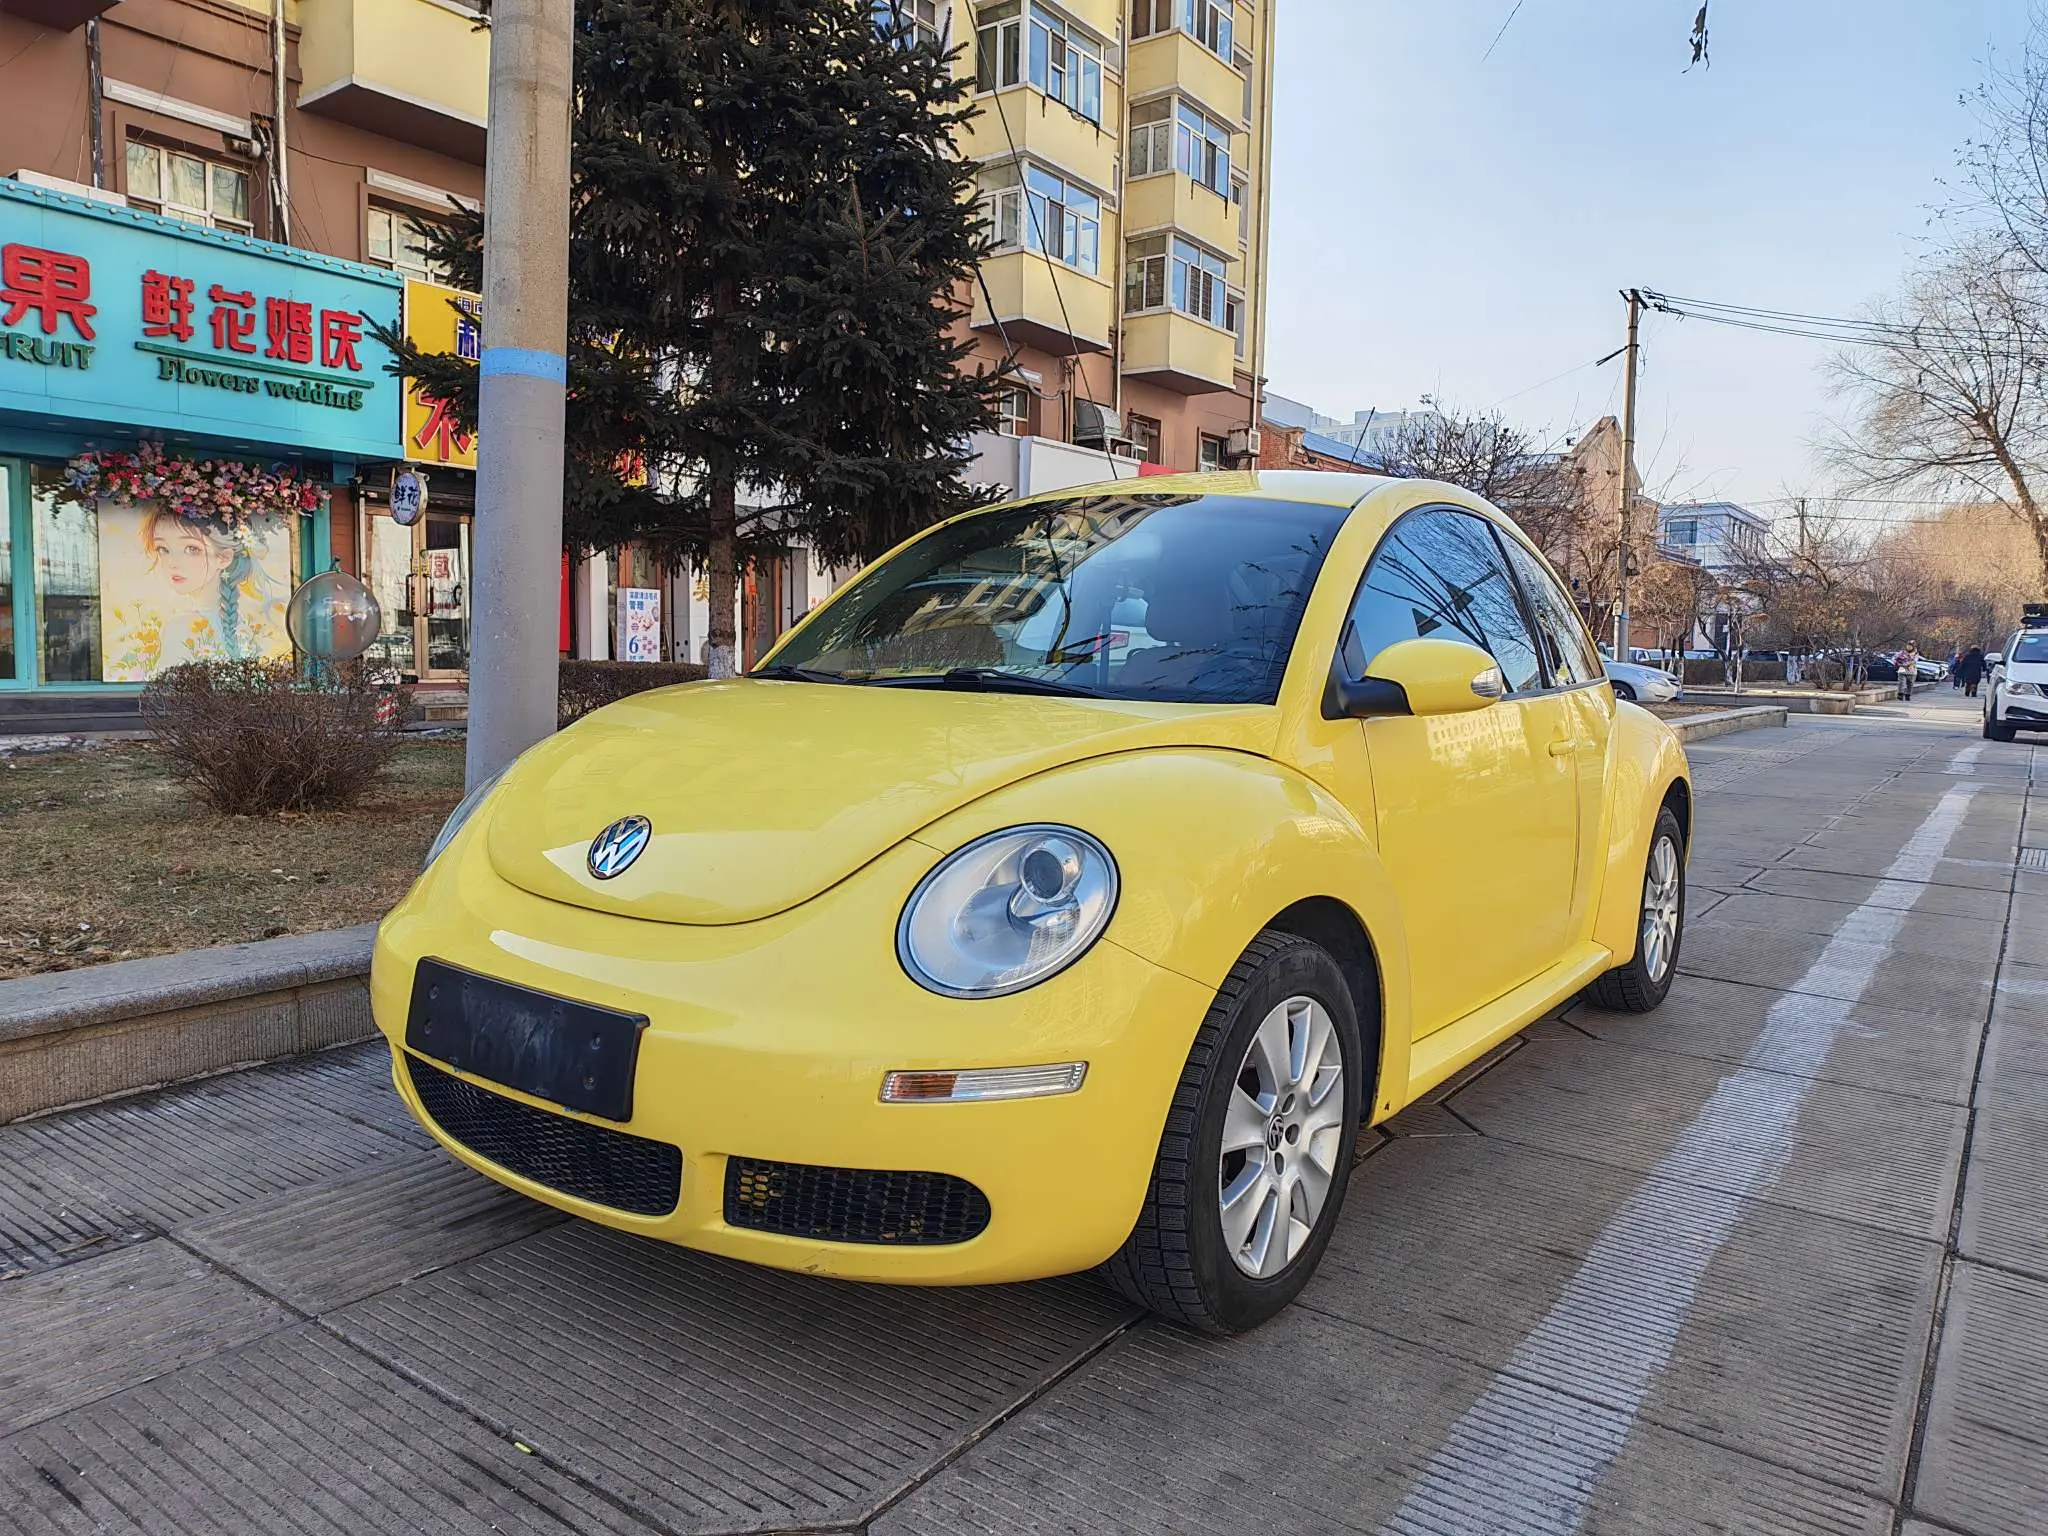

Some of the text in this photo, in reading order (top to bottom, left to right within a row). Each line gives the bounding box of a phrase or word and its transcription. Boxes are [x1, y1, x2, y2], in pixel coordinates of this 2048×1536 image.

[0, 243, 97, 341] 果
[142, 269, 363, 371] 鲜花婚庆
[159, 356, 364, 411] Flowers wedding
